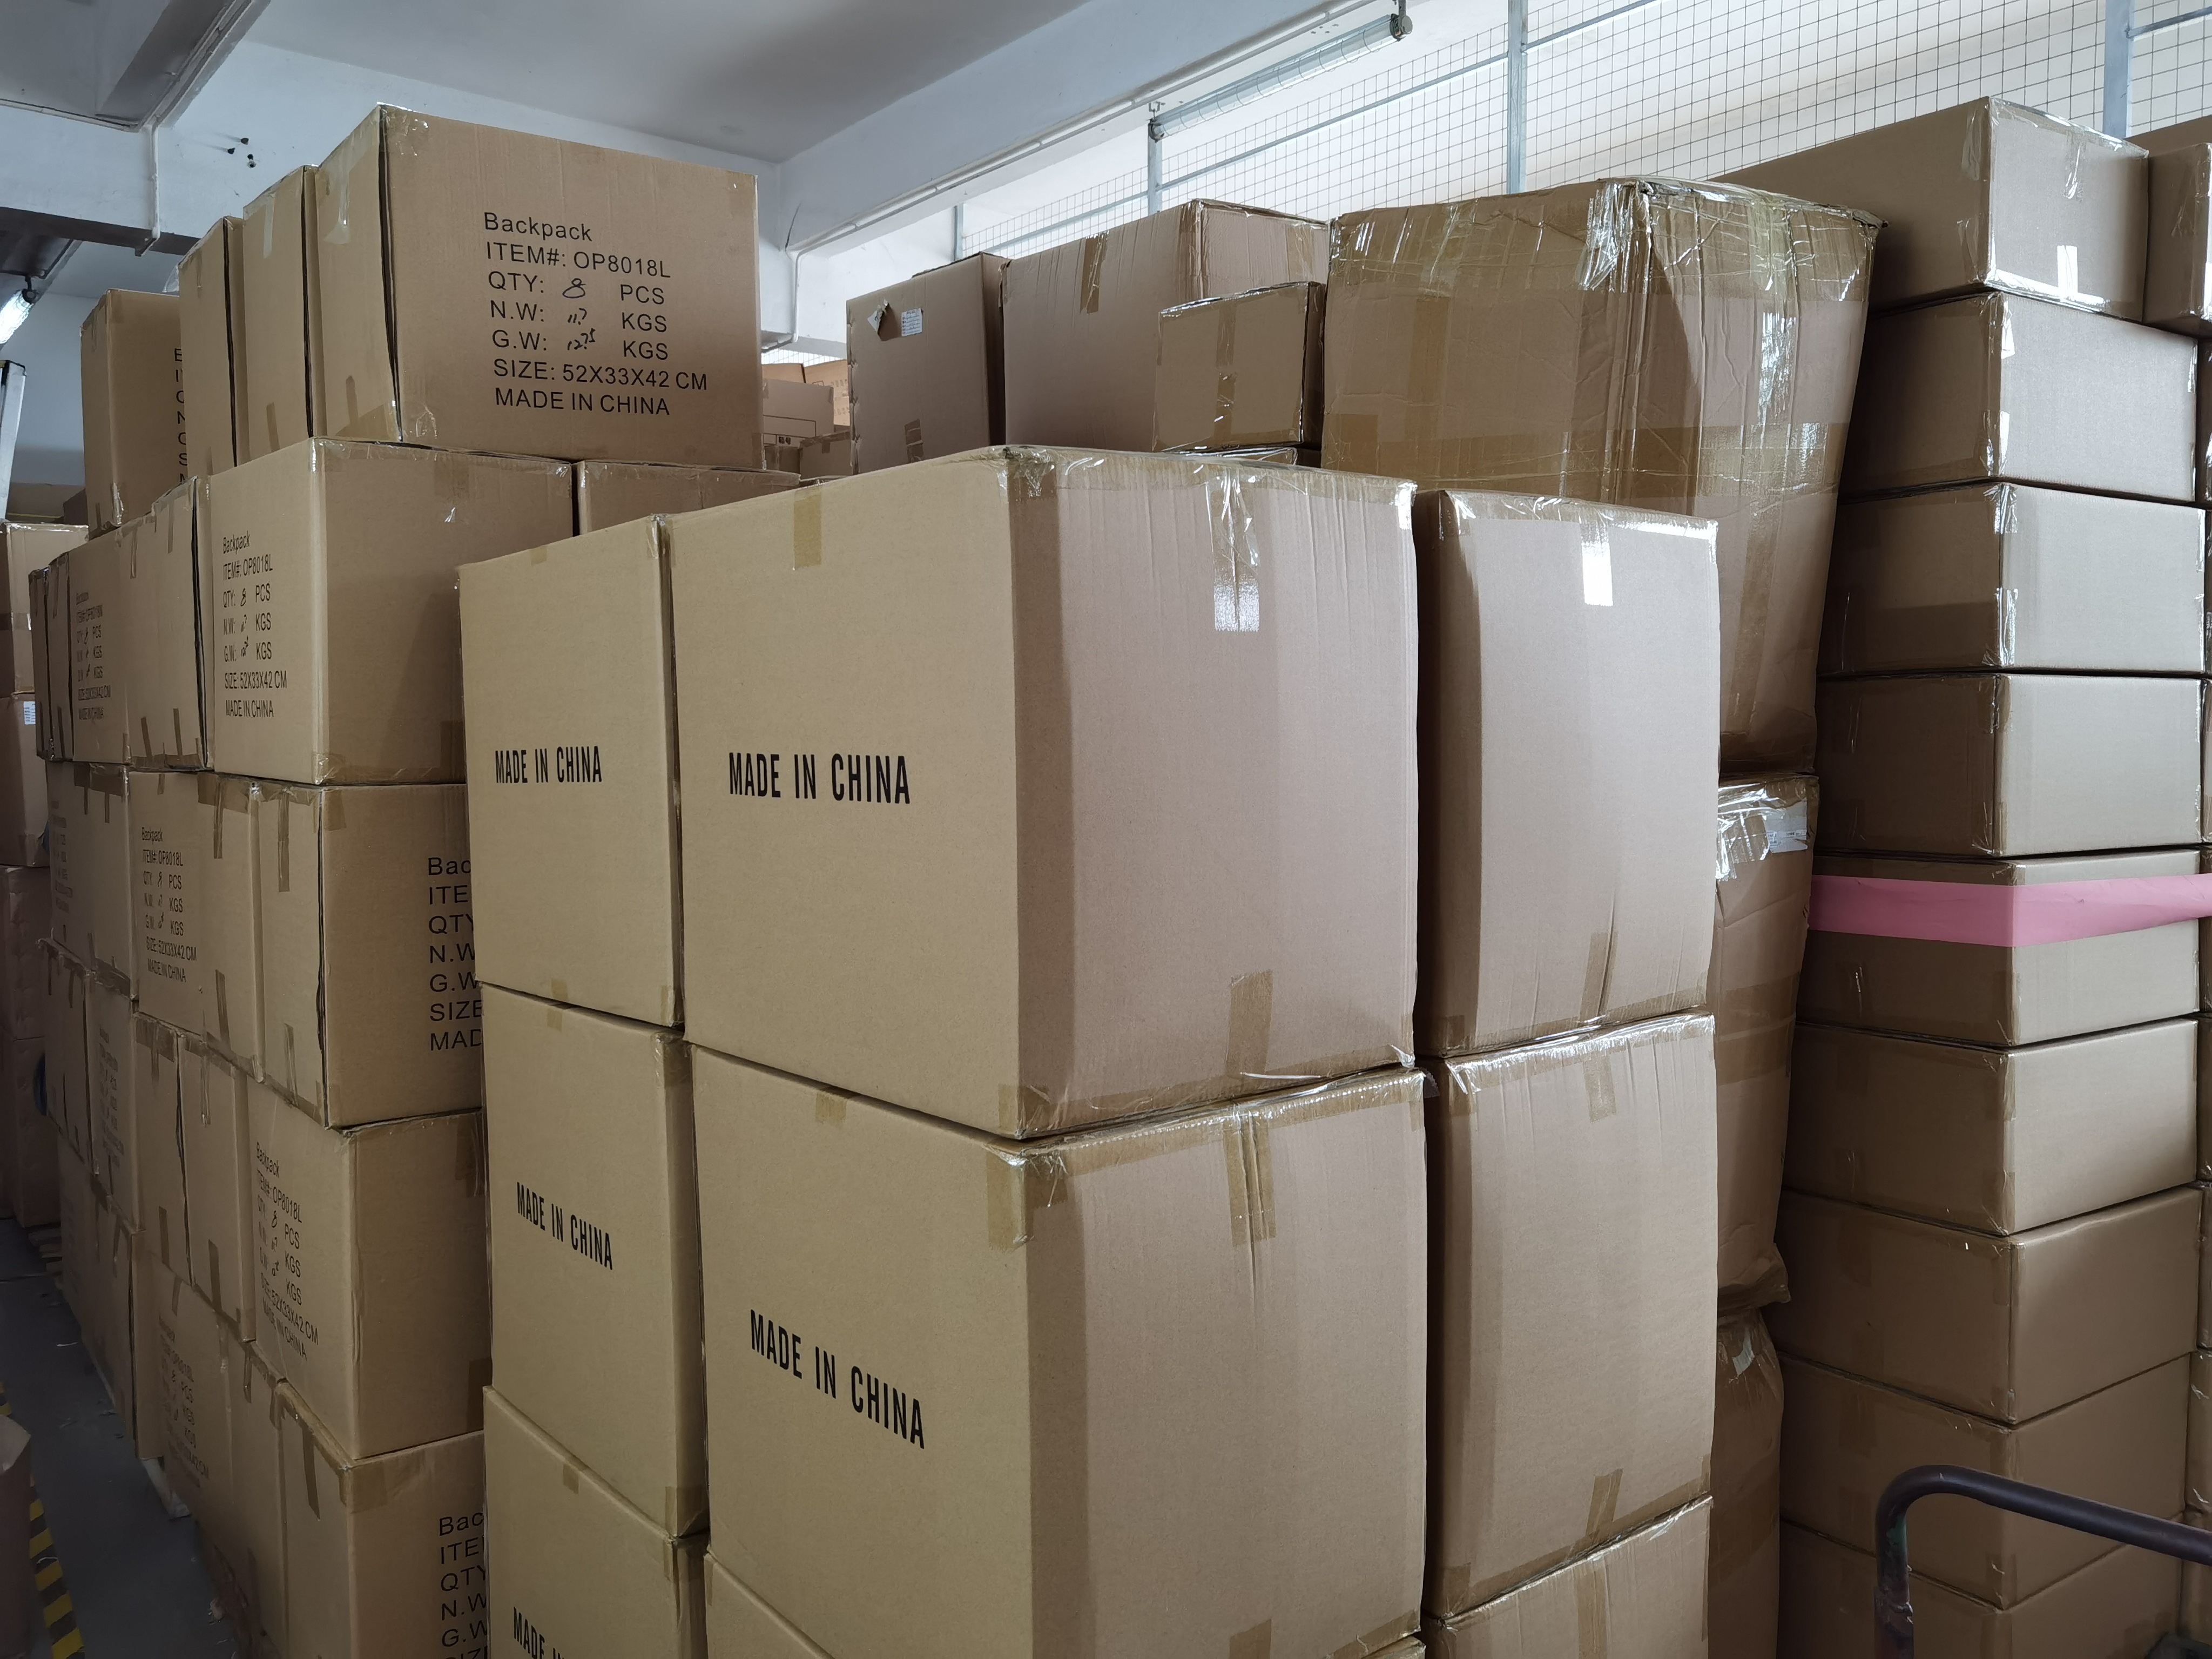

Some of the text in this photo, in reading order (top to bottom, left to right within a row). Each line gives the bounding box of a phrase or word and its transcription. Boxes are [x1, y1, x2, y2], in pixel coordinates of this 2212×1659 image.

[484, 212, 592, 241] Backpack
[487, 241, 671, 278] ITEM#: OP8018L
[488, 271, 665, 305] QTY: 8 PCS
[491, 300, 544, 322] N.W:
[622, 312, 667, 332] KGS
[492, 330, 547, 350] G.W:
[623, 340, 668, 360] KGS
[494, 359, 707, 390] SIZE: 52X33X42 CM
[495, 387, 670, 415] MADE IN CHINA
[223, 530, 250, 554] Backpack
[243, 554, 273, 576] OP8018L
[223, 590, 236, 608] QTY:
[255, 583, 271, 603] PCS
[255, 612, 271, 631] KGS
[256, 642, 272, 660] KGS
[240, 671, 273, 689] 52X33X42
[274, 670, 287, 689] CM
[226, 700, 274, 718] MADE IN CHINA
[495, 746, 602, 784] MADE IN CHINA
[729, 752, 910, 804] MADE IN CHINA
[169, 874, 182, 889] PCS
[169, 898, 183, 913] KGS
[171, 920, 184, 936] KGS
[186, 946, 197, 961] CM
[273, 1186, 302, 1223] OP8018L
[285, 1223, 300, 1250] PCS
[517, 1182, 612, 1270] MADE IN CHINA
[285, 1250, 301, 1278] KGS
[286, 1278, 302, 1306] KGS
[305, 1324, 319, 1345] CM
[751, 1309, 924, 1449] MADE IN CHINA
[514, 1607, 545, 1659] MADE
